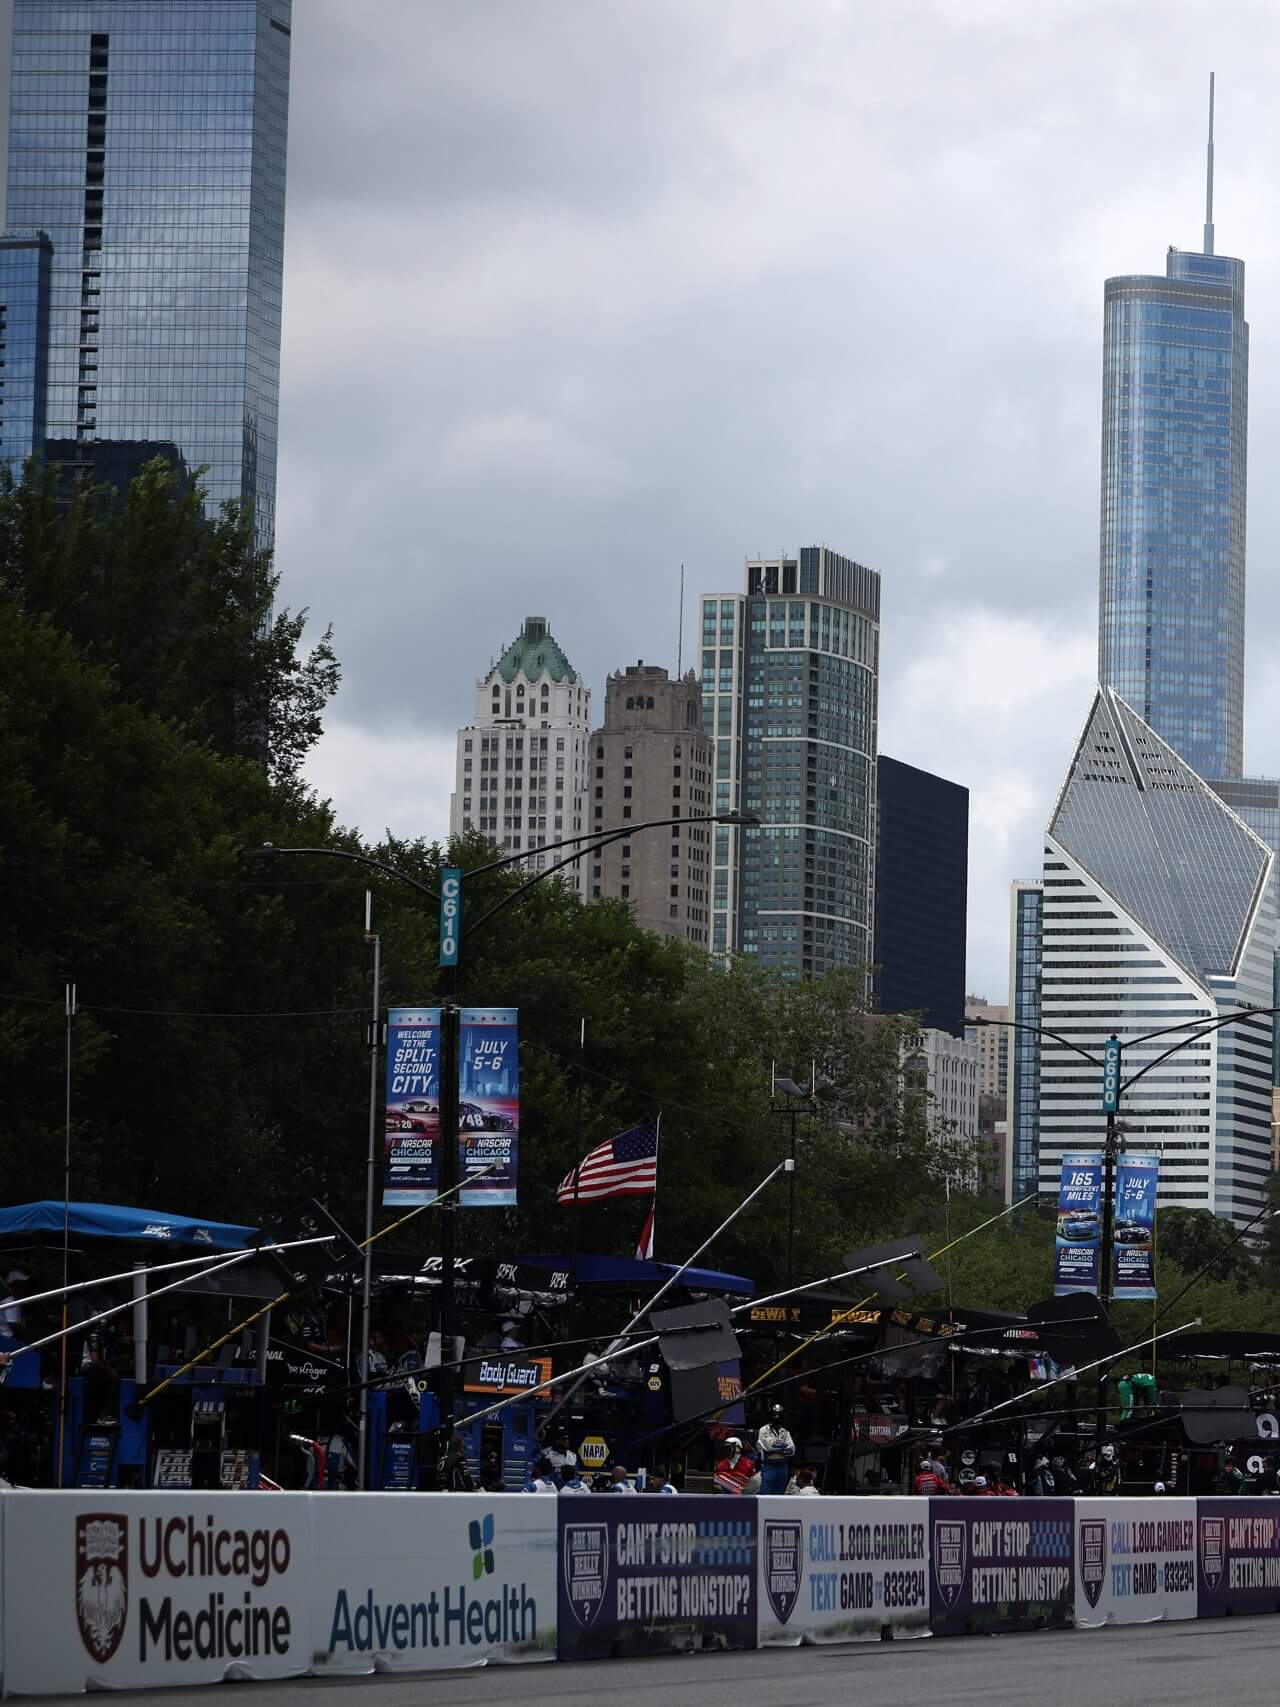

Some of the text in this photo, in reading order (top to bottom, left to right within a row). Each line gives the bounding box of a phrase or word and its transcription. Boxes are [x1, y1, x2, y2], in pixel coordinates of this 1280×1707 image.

[442, 878, 459, 955] C610
[397, 1030, 432, 1039] WELCOME
[403, 1039, 427, 1047] TO THE
[394, 1048, 436, 1062] SPLIT-
[475, 1040, 508, 1054] JULY
[393, 1063, 432, 1074] SECOND
[473, 1056, 503, 1070] 5-6
[1105, 1047, 1118, 1104] C600
[391, 1075, 433, 1094] CITY
[400, 1139, 433, 1148] NASCAR
[466, 1147, 511, 1156] CHICAGO
[477, 1138, 512, 1148] NASCAR
[390, 1148, 432, 1157] CHICAGO
[1069, 1172, 1094, 1186] 165
[1125, 1178, 1149, 1189] JULY
[1066, 1191, 1094, 1201] MILES
[1124, 1189, 1145, 1200] 5-6
[1059, 1254, 1093, 1262] CHICAGO
[1068, 1247, 1094, 1255] NASCAR
[1126, 1249, 1148, 1257] NASCAR
[419, 1256, 475, 1272] RK
[751, 1307, 800, 1321] DEWAT
[299, 1362, 328, 1380] Kroger
[480, 1361, 539, 1390] Body Guard
[648, 1363, 660, 1373] 9
[583, 1442, 605, 1458] NAPA
[573, 1530, 601, 1550] ARE YOU
[972, 1521, 1030, 1557] CAN'T STOP
[1111, 1522, 1131, 1555] CALL
[1132, 1520, 1194, 1553] 1.800.GAMBLER
[1229, 1518, 1253, 1549] CAN'T
[1253, 1518, 1274, 1549] STOP
[140, 1515, 290, 1587] UChicago
[617, 1523, 697, 1566] CAN'T STOP
[809, 1524, 925, 1562] CALL 1.800.GAMBLER
[574, 1555, 600, 1576] REALLY
[773, 1552, 794, 1570] REALLY
[1111, 1564, 1132, 1596] TEXT
[1133, 1562, 1157, 1595] GAMB
[1164, 1560, 1194, 1592] 833234
[1229, 1557, 1264, 1589] BETTING
[572, 1580, 602, 1601] WINNING
[809, 1573, 838, 1611] TEXT
[840, 1572, 874, 1609] GAMB
[884, 1570, 925, 1607] 833234
[972, 1567, 1017, 1603] BETTING
[1018, 1567, 1070, 1601] NONSTOP?
[617, 1575, 751, 1620] BETTING NONSTOP?
[779, 1594, 787, 1611] ?
[948, 1586, 953, 1603] ?
[583, 1602, 591, 1621] ?
[140, 1591, 291, 1662] Medicine
